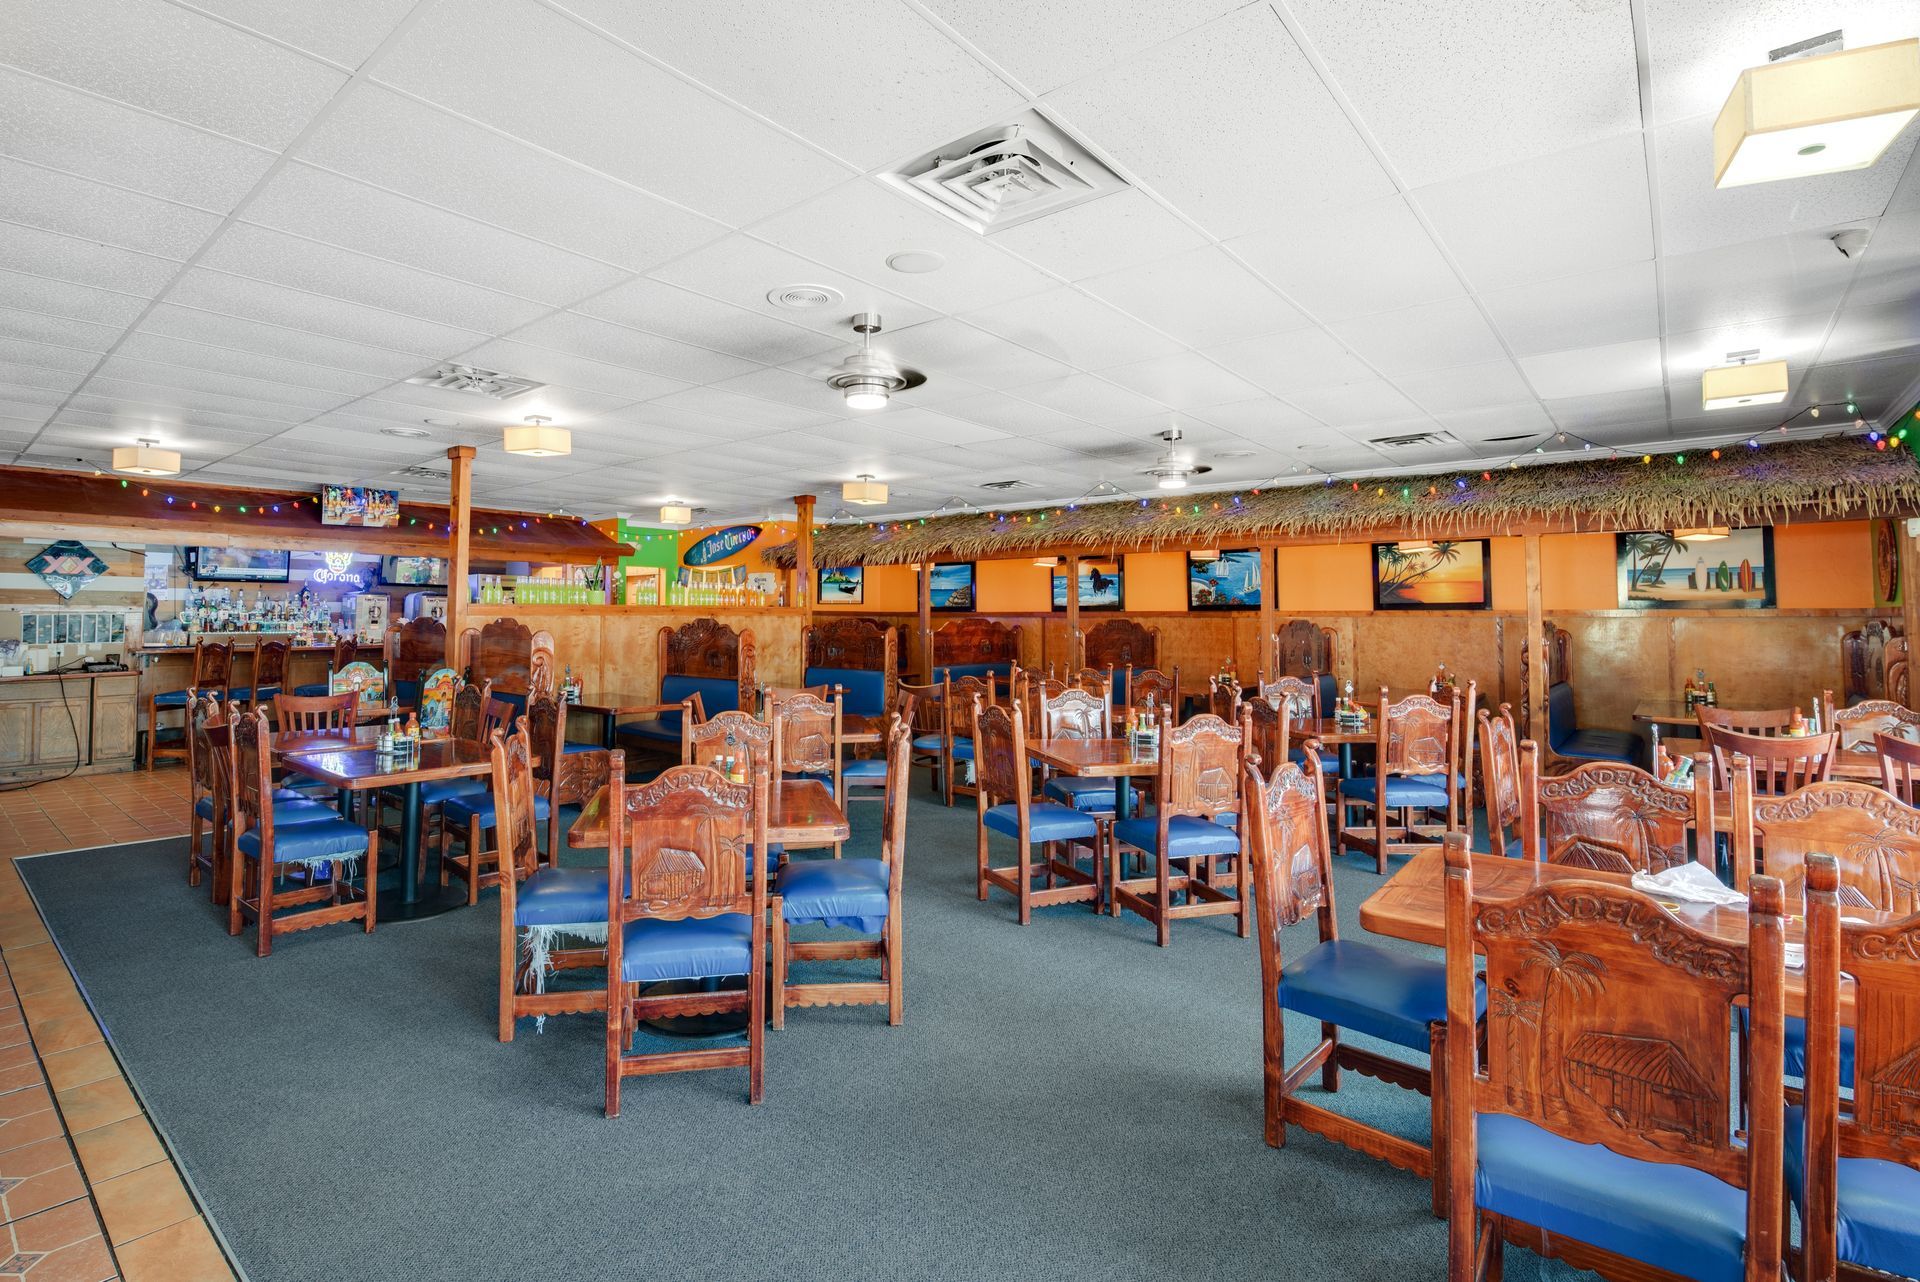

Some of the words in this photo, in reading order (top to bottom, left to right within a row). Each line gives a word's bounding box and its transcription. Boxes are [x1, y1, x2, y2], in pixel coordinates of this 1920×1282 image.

[706, 540, 724, 558] Jose
[724, 528, 752, 550] Cuervo
[42, 555, 96, 576] XX
[313, 568, 361, 584] Corona
[1541, 771, 1596, 799] CASA
[1595, 769, 1640, 788] DEL
[1632, 779, 1689, 811] MAR
[1755, 791, 1825, 822] CASA
[1823, 789, 1876, 810] DEL
[1474, 893, 1573, 934] CASA
[1568, 895, 1648, 929] DEL
[1631, 918, 1741, 983] MAR
